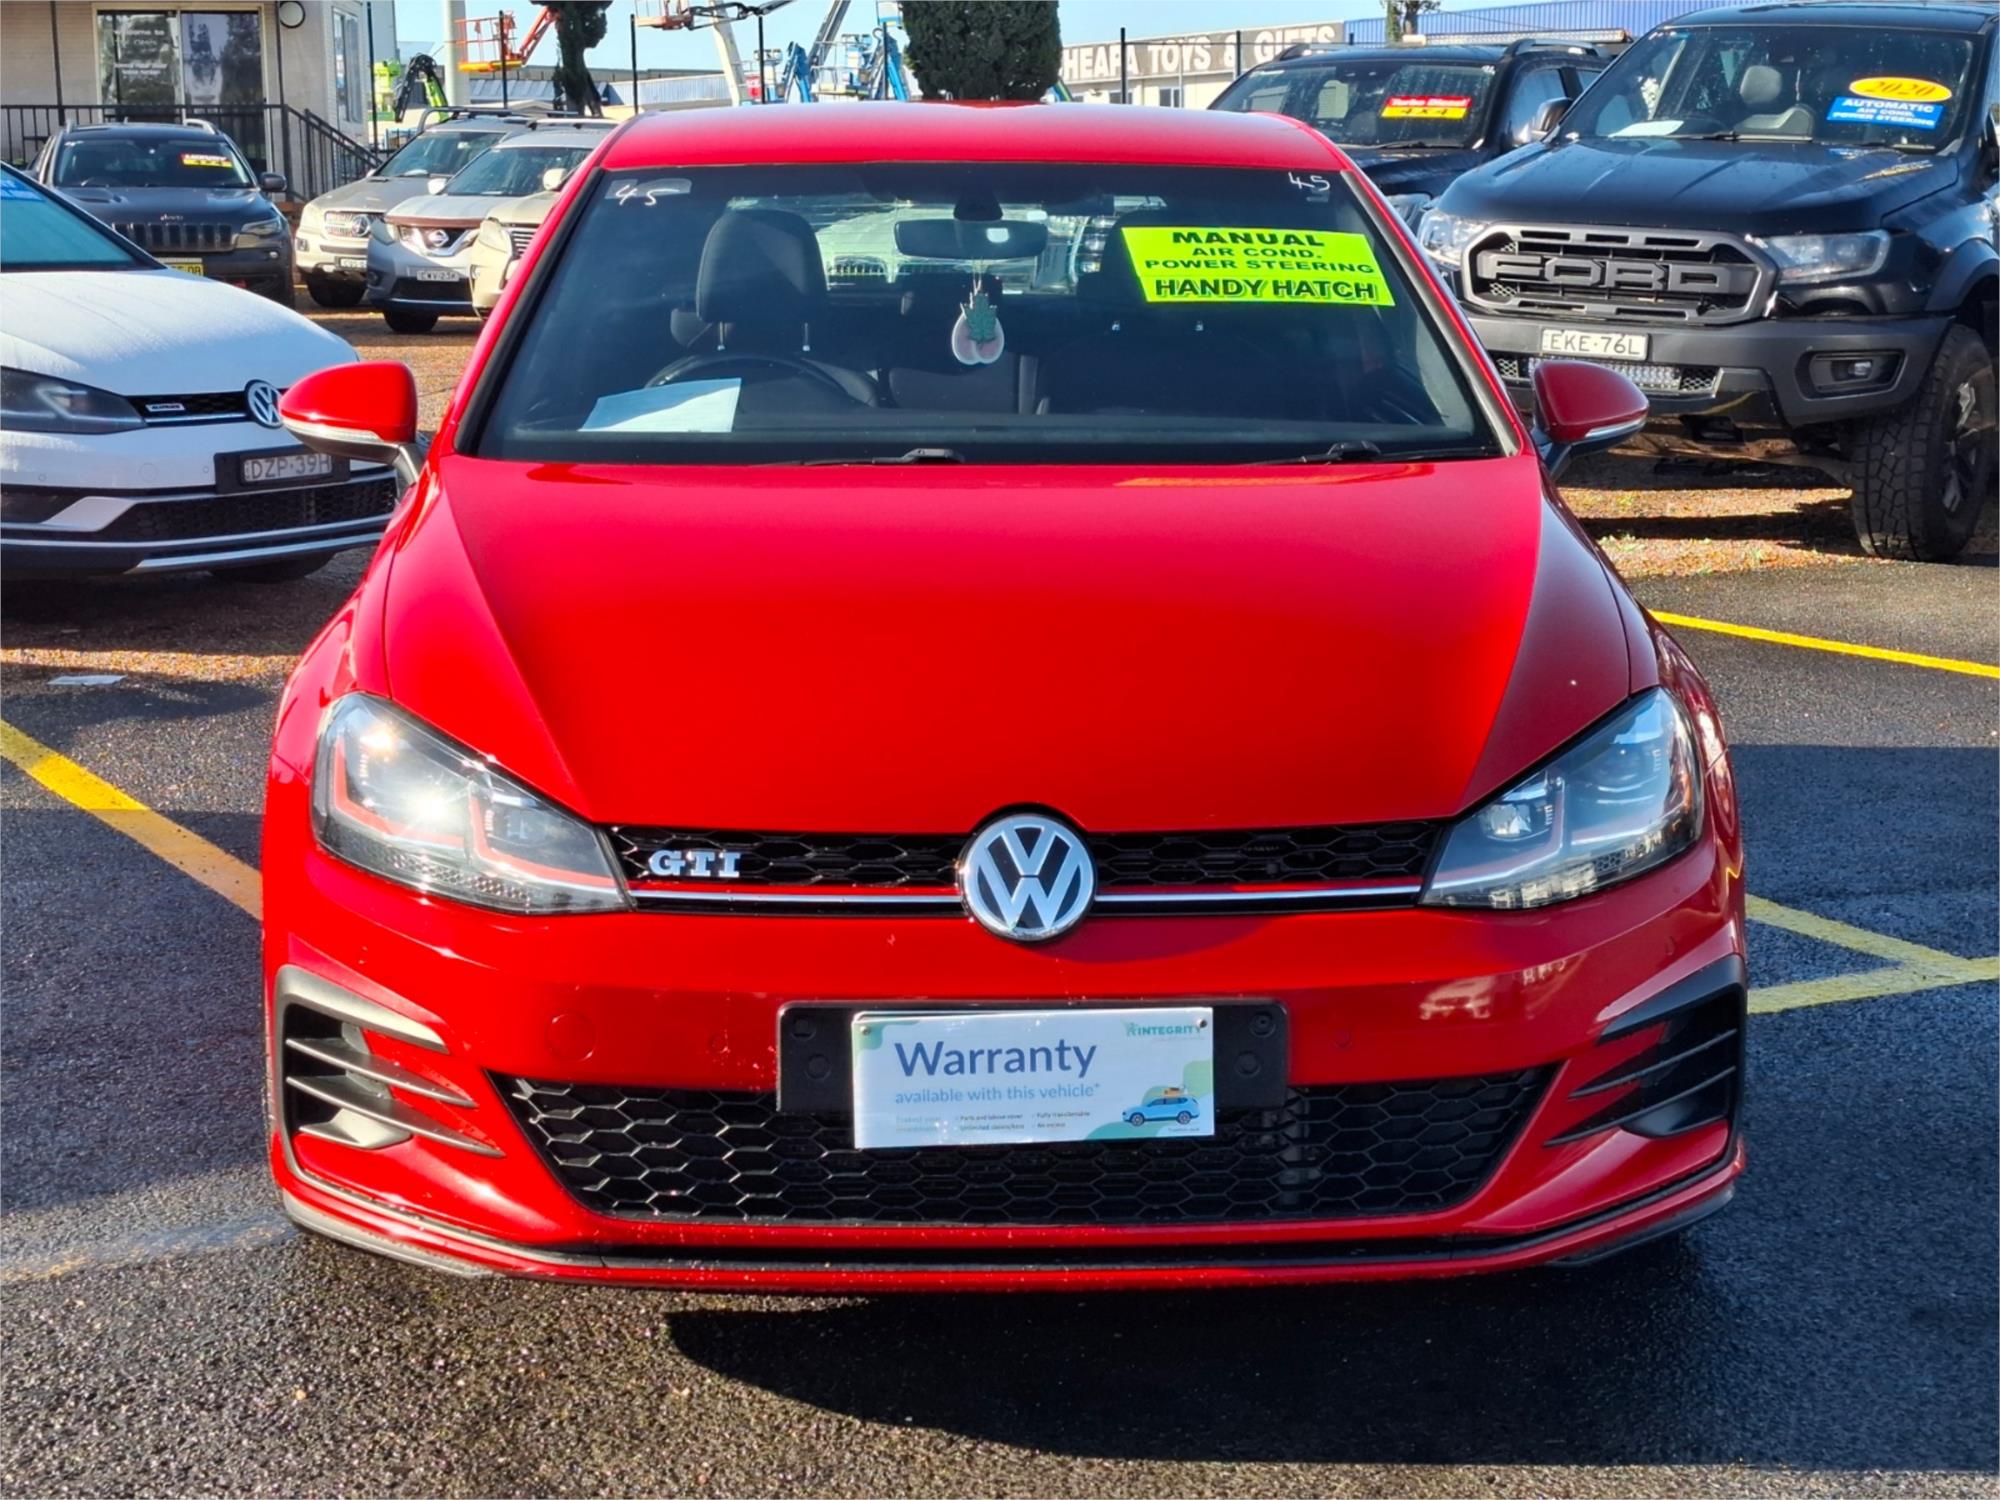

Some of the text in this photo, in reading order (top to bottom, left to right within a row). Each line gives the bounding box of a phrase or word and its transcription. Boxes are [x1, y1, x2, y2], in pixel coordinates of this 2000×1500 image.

[1059, 43, 1141, 79] HEAPA
[1147, 35, 1211, 73] TOYS
[1254, 26, 1336, 65] GIFTS
[1864, 81, 1936, 97] 2020
[1832, 111, 1874, 120] POWER
[1841, 98, 1935, 113] AUTOMATIC
[1288, 172, 1331, 192] 45
[615, 184, 680, 206] 45
[1172, 231, 1325, 247] MANUAL
[1192, 247, 1322, 259] AIR COND.
[1145, 259, 1374, 274] POWER STEERING
[1477, 252, 1731, 294] FORD
[1155, 279, 1377, 300] HANDY HATCH
[649, 849, 740, 878] GTI
[894, 1039, 1097, 1078] Warranty
[895, 1085, 963, 1104] available
[967, 1085, 1002, 1101] with
[1006, 1083, 1036, 1100] this
